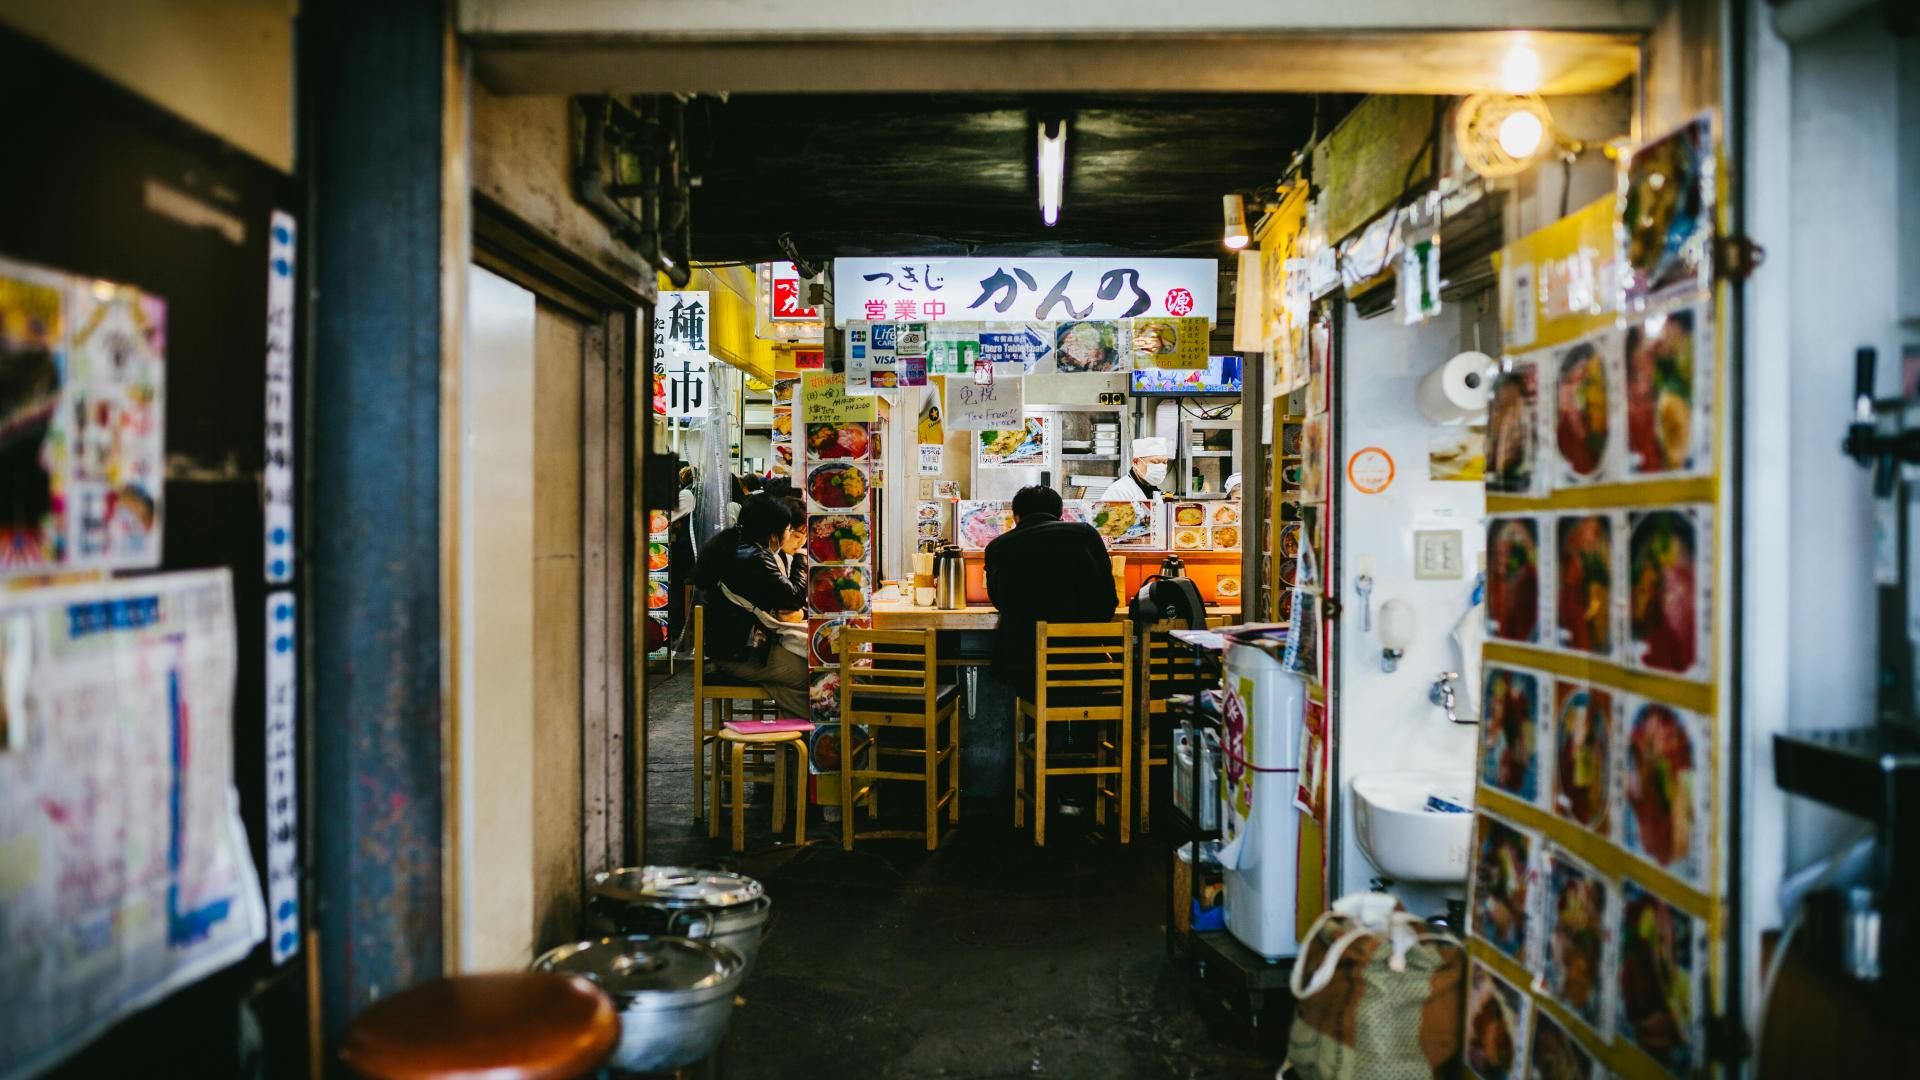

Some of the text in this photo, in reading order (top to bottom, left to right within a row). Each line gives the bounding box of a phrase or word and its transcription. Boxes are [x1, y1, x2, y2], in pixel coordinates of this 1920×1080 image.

[863, 264, 944, 291] つきじ
[864, 299, 945, 321] 営業中
[874, 327, 896, 340] Life
[668, 300, 706, 414] 種市
[874, 355, 896, 365] VISA
